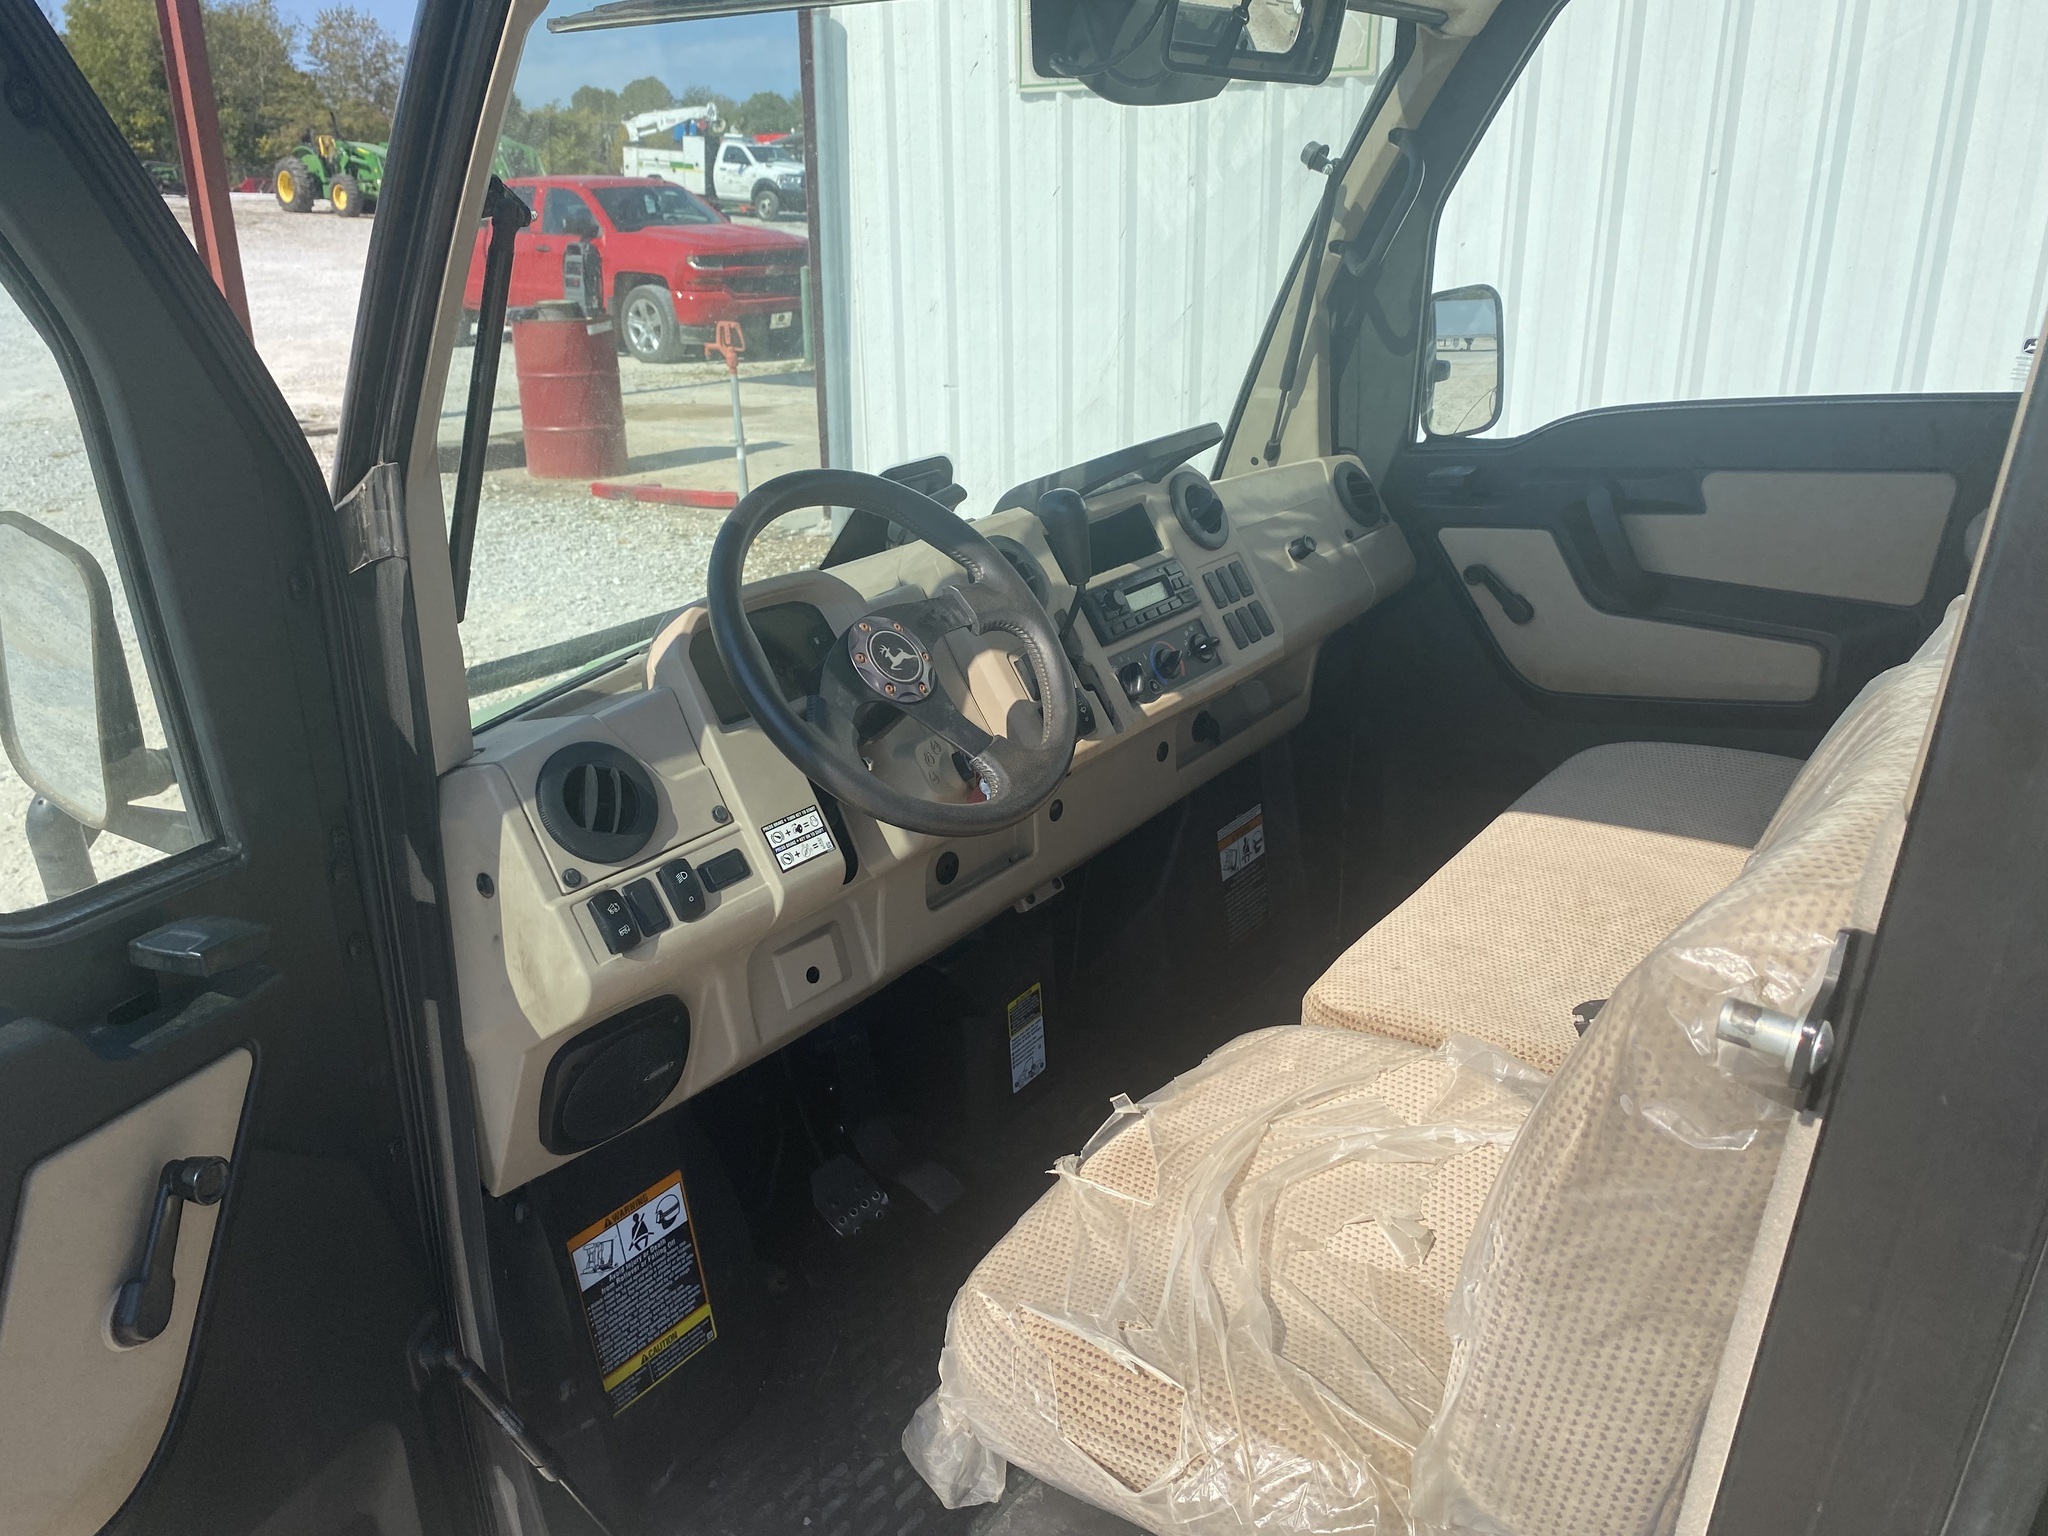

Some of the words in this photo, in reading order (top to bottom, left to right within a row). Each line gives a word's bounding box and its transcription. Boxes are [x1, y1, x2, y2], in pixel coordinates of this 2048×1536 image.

[611, 1193, 649, 1222] WARNING
[600, 1280, 615, 1294] from
[615, 1263, 639, 1284] Rollover
[647, 1244, 667, 1263] Falling
[607, 1265, 625, 1281] Avoid
[625, 1253, 642, 1271] Injury
[649, 1237, 666, 1253] Death
[647, 1330, 678, 1358] CAUTION
